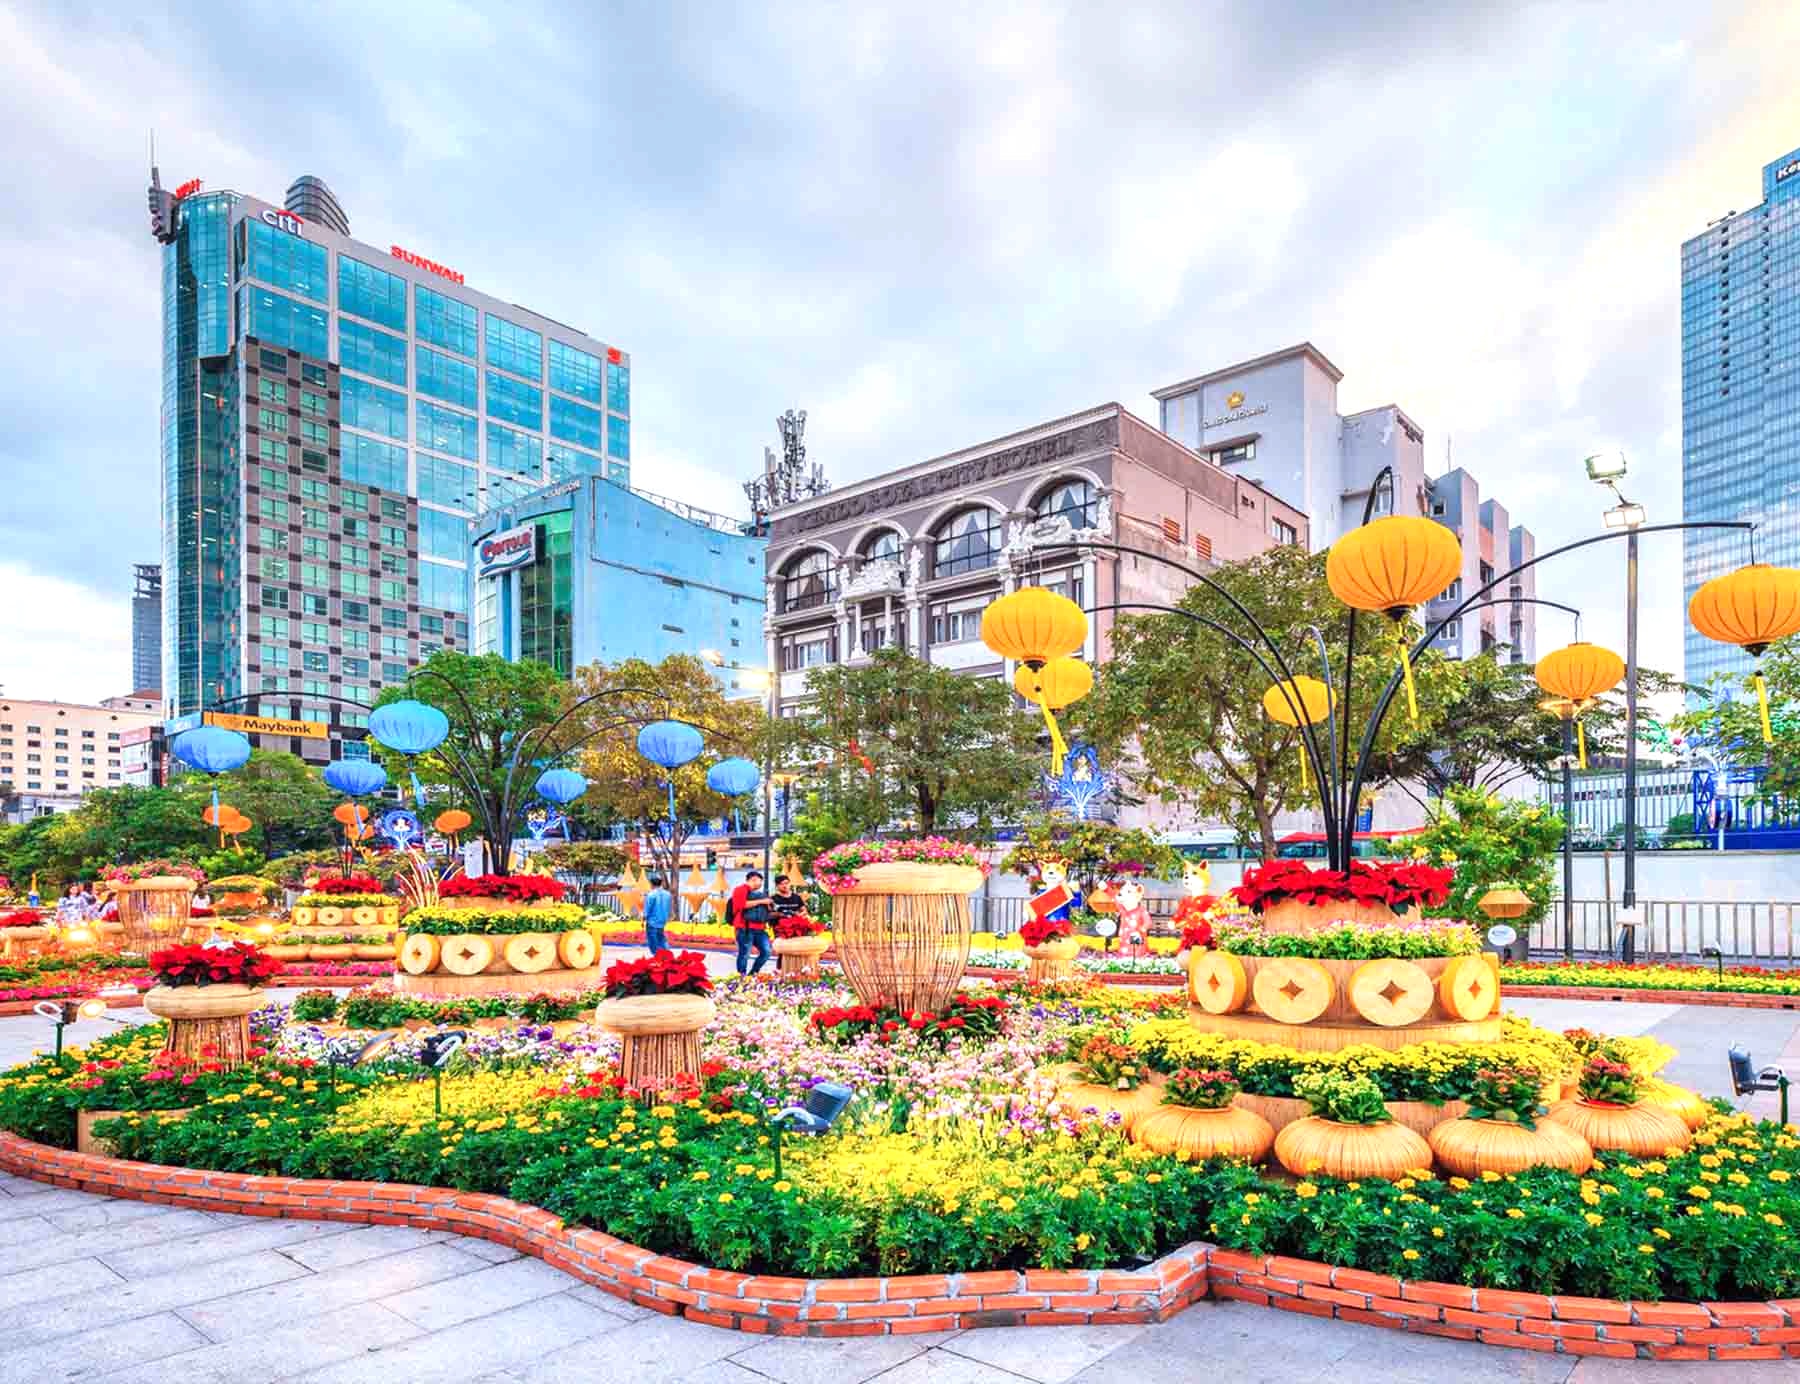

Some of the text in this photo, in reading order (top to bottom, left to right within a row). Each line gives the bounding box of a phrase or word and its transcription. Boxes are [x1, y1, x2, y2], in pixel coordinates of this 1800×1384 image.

[1778, 162, 1800, 180] Ke
[262, 209, 304, 236] citi
[391, 245, 465, 285] SUNWAH
[936, 459, 988, 490] CITY
[992, 436, 1074, 475] HOTEL
[243, 718, 312, 736] Maybank
